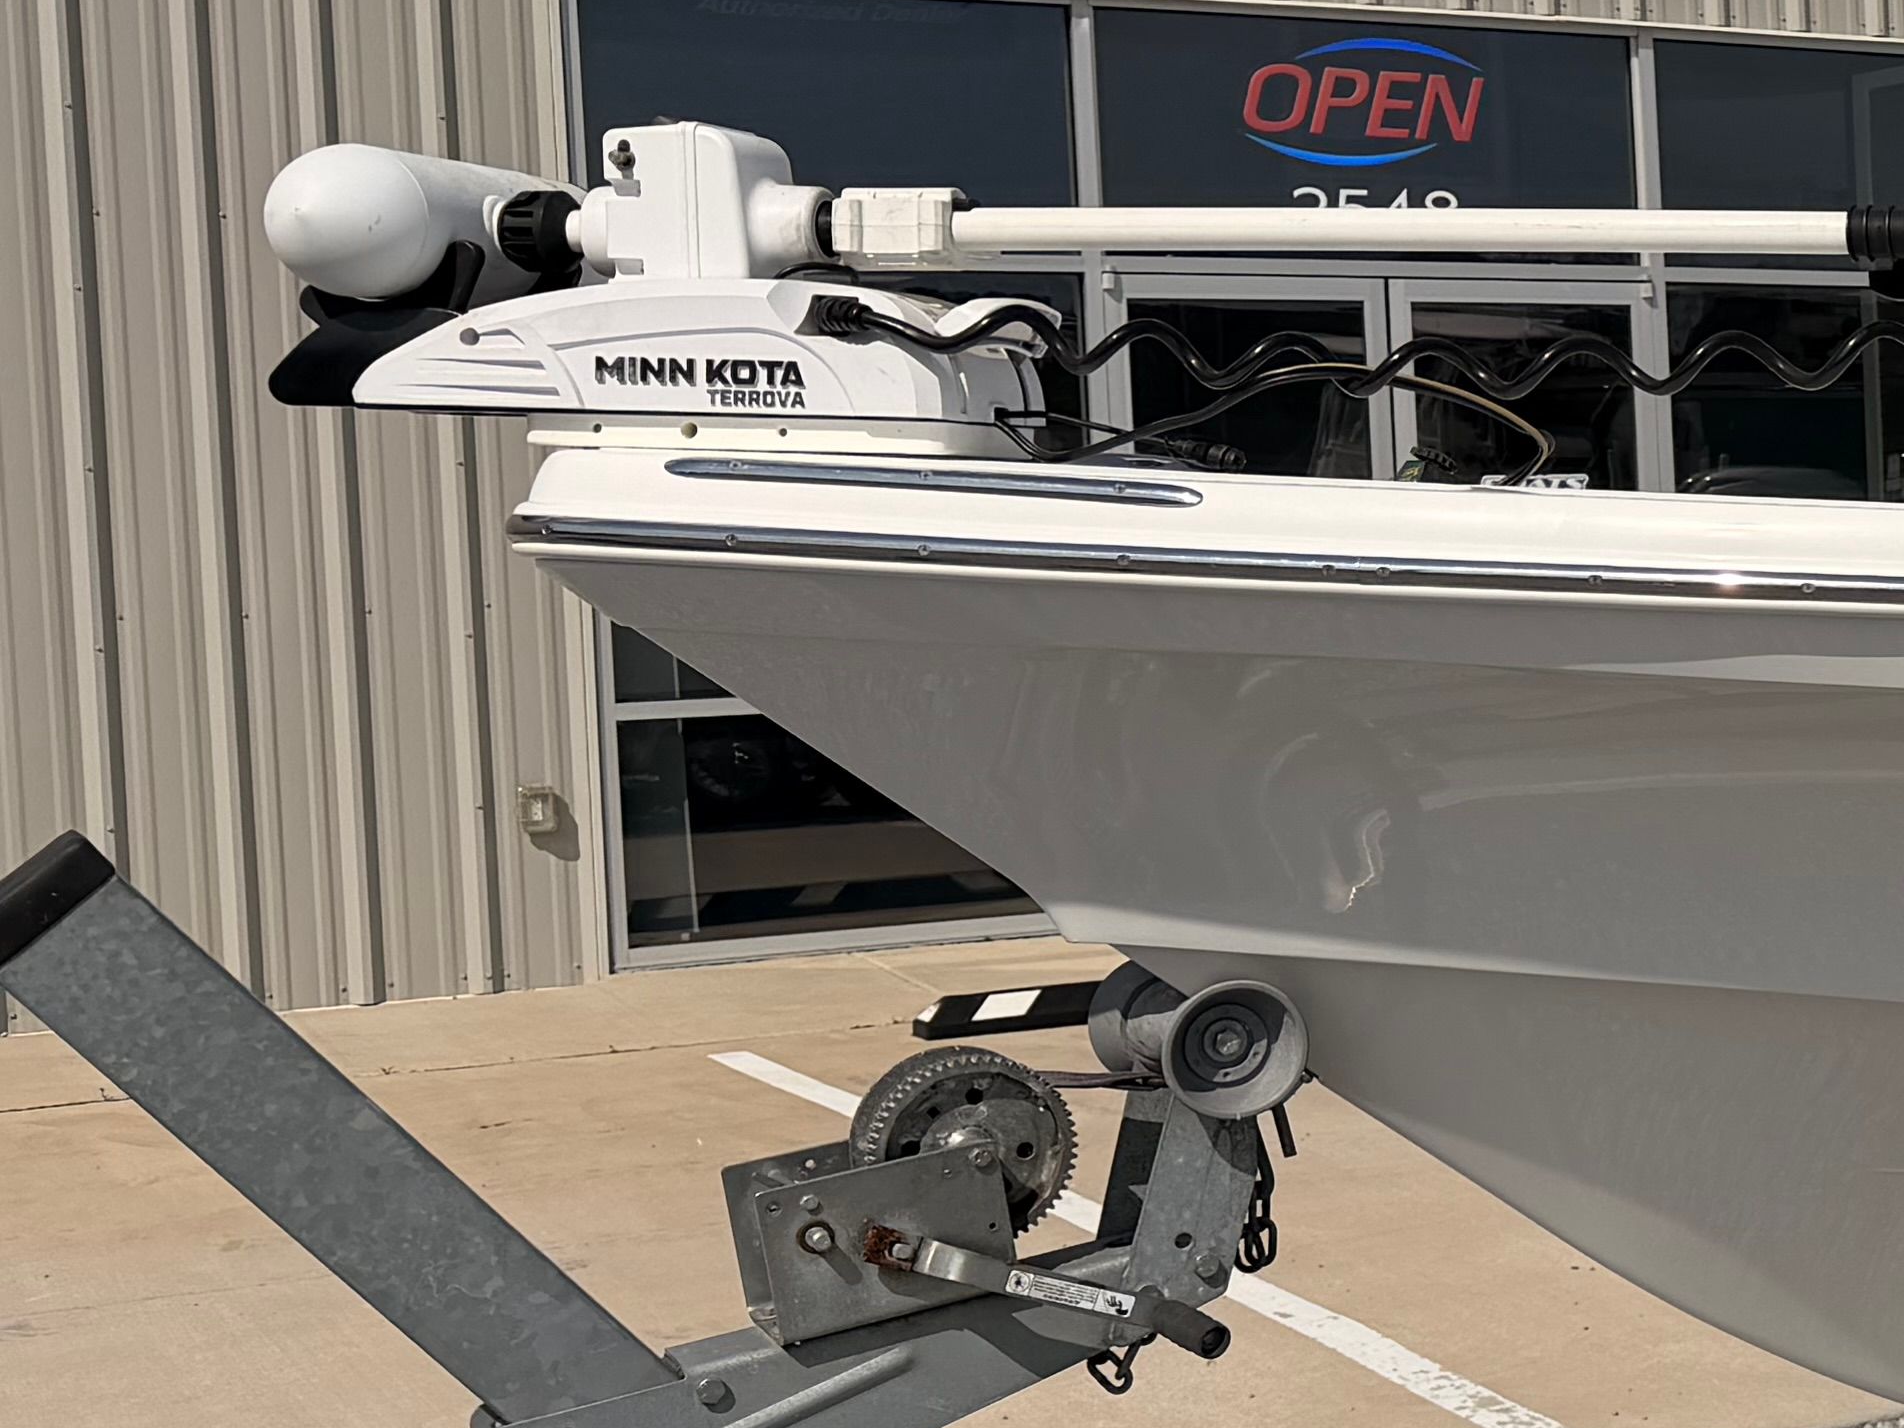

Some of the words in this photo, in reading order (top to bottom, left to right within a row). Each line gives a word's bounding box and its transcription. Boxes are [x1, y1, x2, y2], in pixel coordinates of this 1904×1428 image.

[1243, 63, 1485, 142] OPEN
[594, 355, 697, 387] MINN
[705, 358, 807, 389] KOTA
[706, 388, 807, 409] TERROVA
